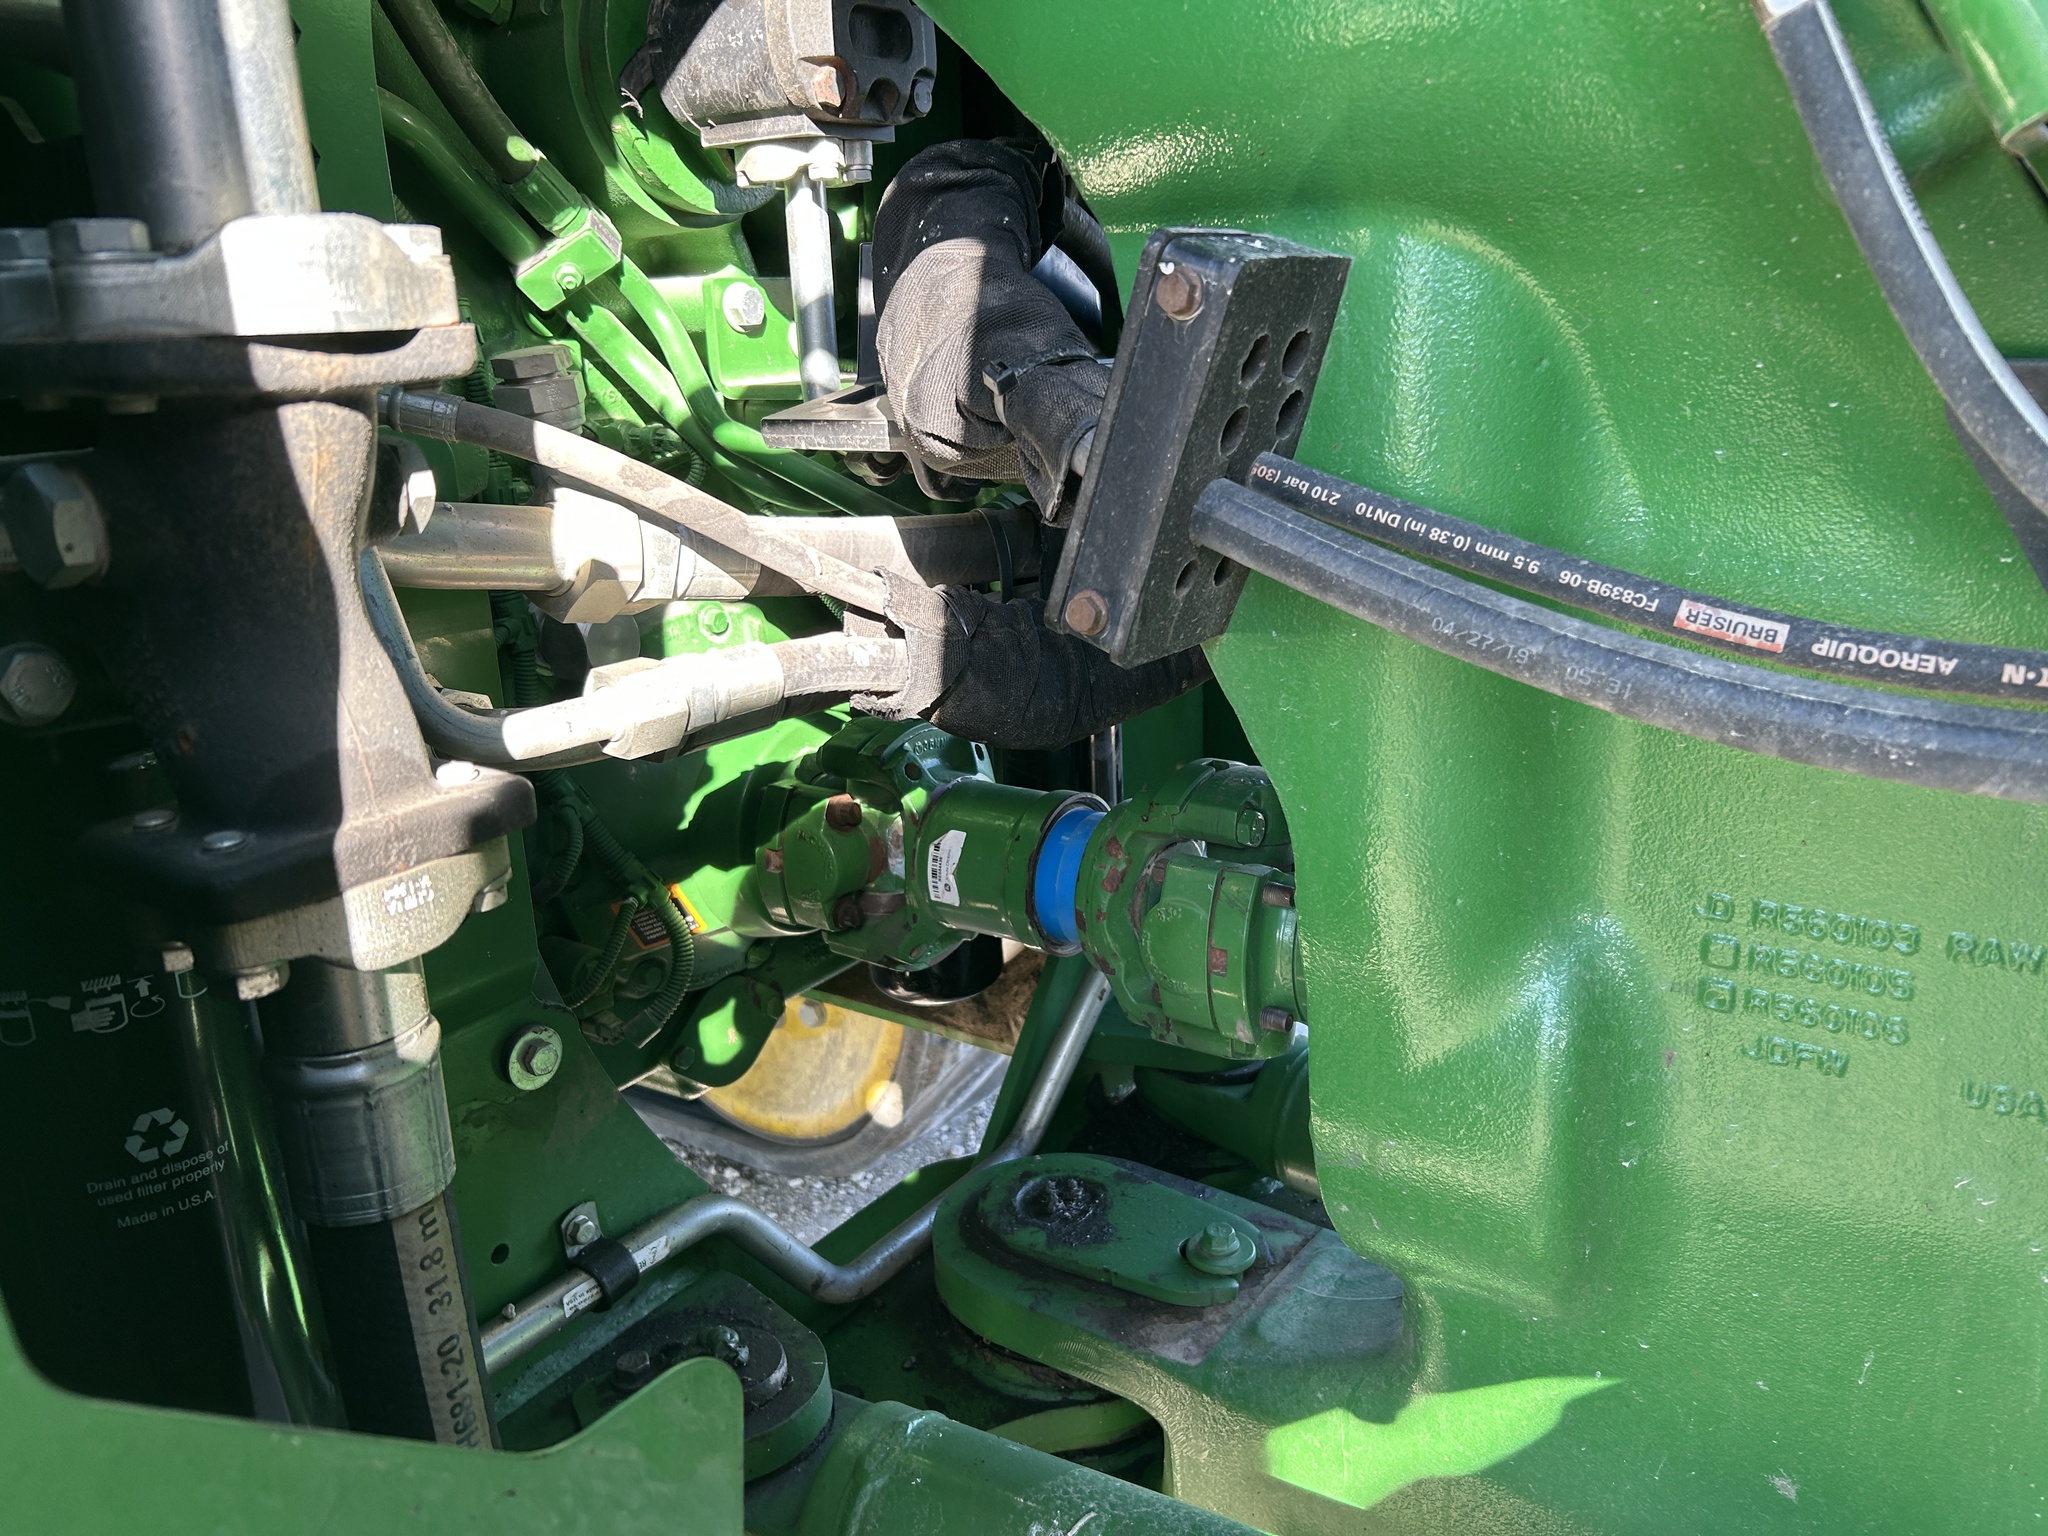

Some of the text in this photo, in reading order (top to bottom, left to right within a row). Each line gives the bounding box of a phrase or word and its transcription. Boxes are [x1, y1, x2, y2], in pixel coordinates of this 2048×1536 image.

[1282, 475, 1310, 493] bar
[1311, 486, 1342, 506] 210
[1354, 501, 1402, 529] DN10
[1403, 516, 1428, 537] in)
[1429, 527, 1472, 552] (0.38
[1475, 541, 1510, 562] mm
[1512, 555, 1541, 575] 9.5
[1558, 569, 1660, 613] FC839B-06
[1685, 607, 1779, 644] BRUISER
[1810, 638, 1960, 676] AEROQUIP
[1945, 930, 2048, 976] RAW
[1960, 1077, 2048, 1124] USA
[86, 1140, 230, 1194] Drain and dispose of
[97, 1159, 226, 1207] used filter properly
[117, 1189, 217, 1229] Made in U.S.A.
[419, 1246, 453, 1317] 31.8
